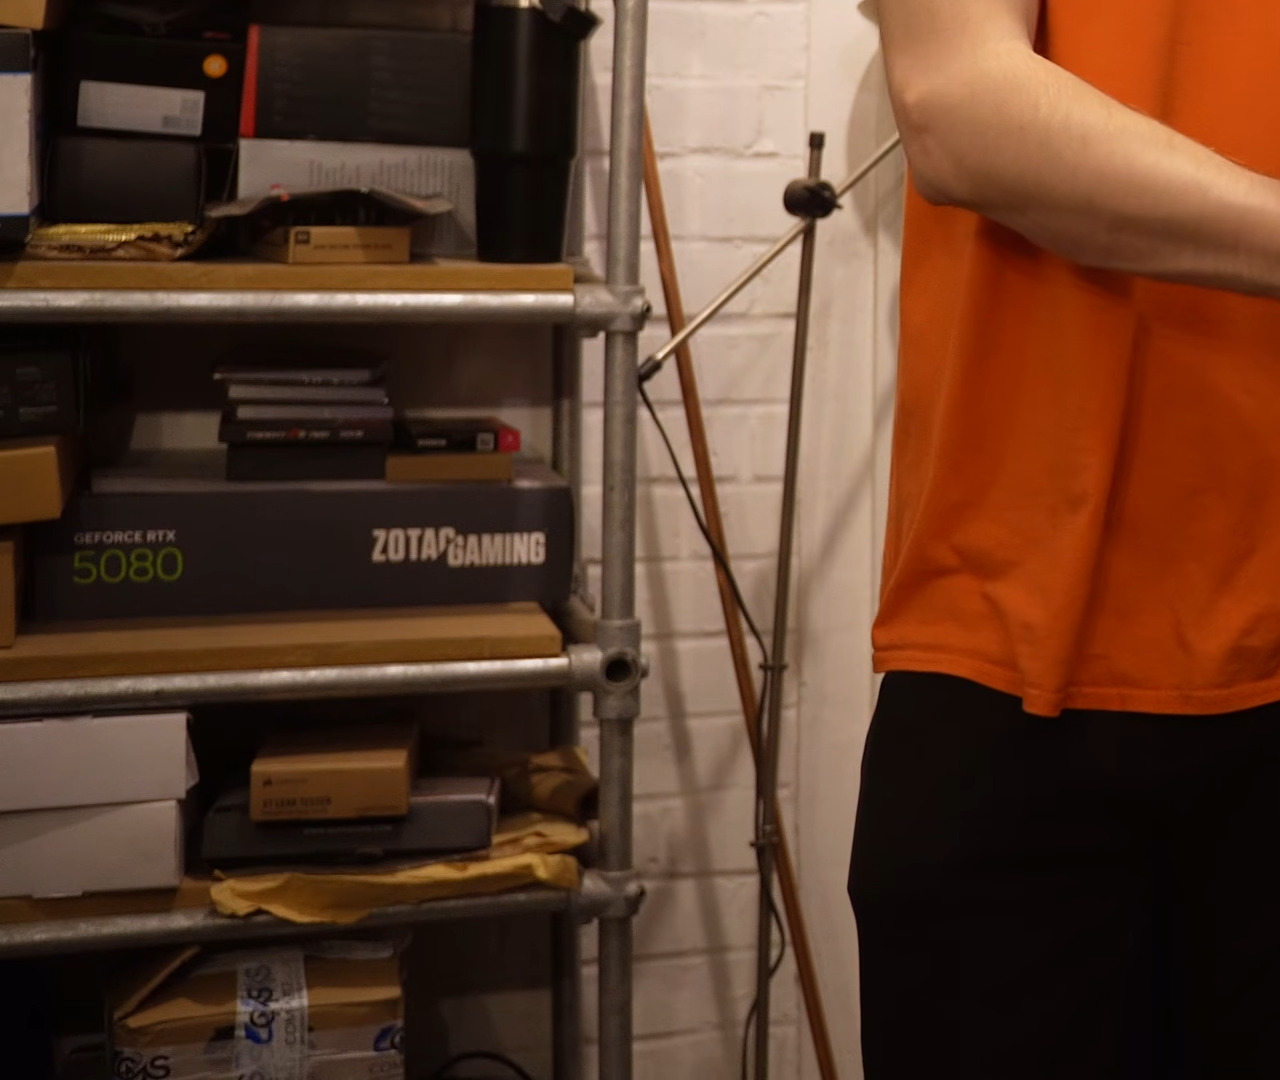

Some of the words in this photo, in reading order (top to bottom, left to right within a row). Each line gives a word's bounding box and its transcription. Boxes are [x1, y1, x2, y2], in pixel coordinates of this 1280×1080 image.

[74, 530, 143, 545] GEFORCE
[146, 529, 177, 544] RTX
[447, 531, 547, 568] GAMING
[73, 547, 184, 584] 5080
